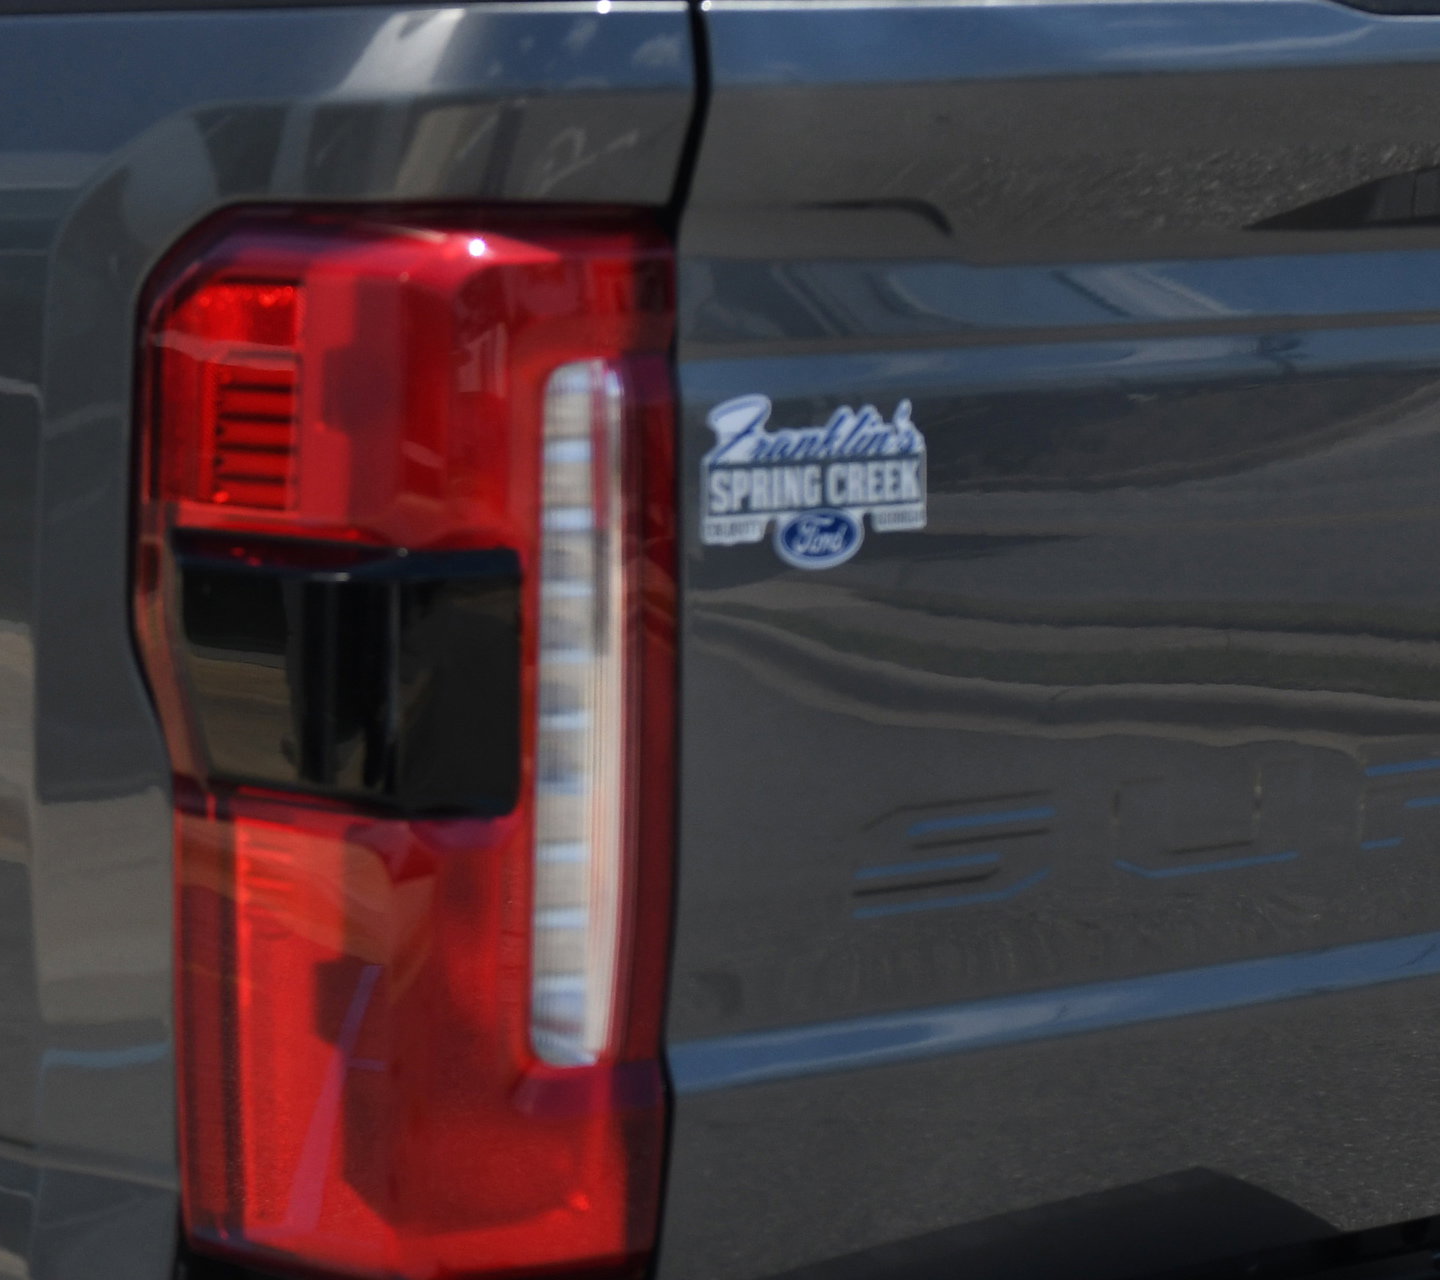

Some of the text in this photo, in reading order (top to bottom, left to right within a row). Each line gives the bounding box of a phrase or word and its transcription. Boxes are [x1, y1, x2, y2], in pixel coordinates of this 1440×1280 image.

[709, 458, 921, 514] SPRING CREEK
[790, 516, 849, 556] Ford
